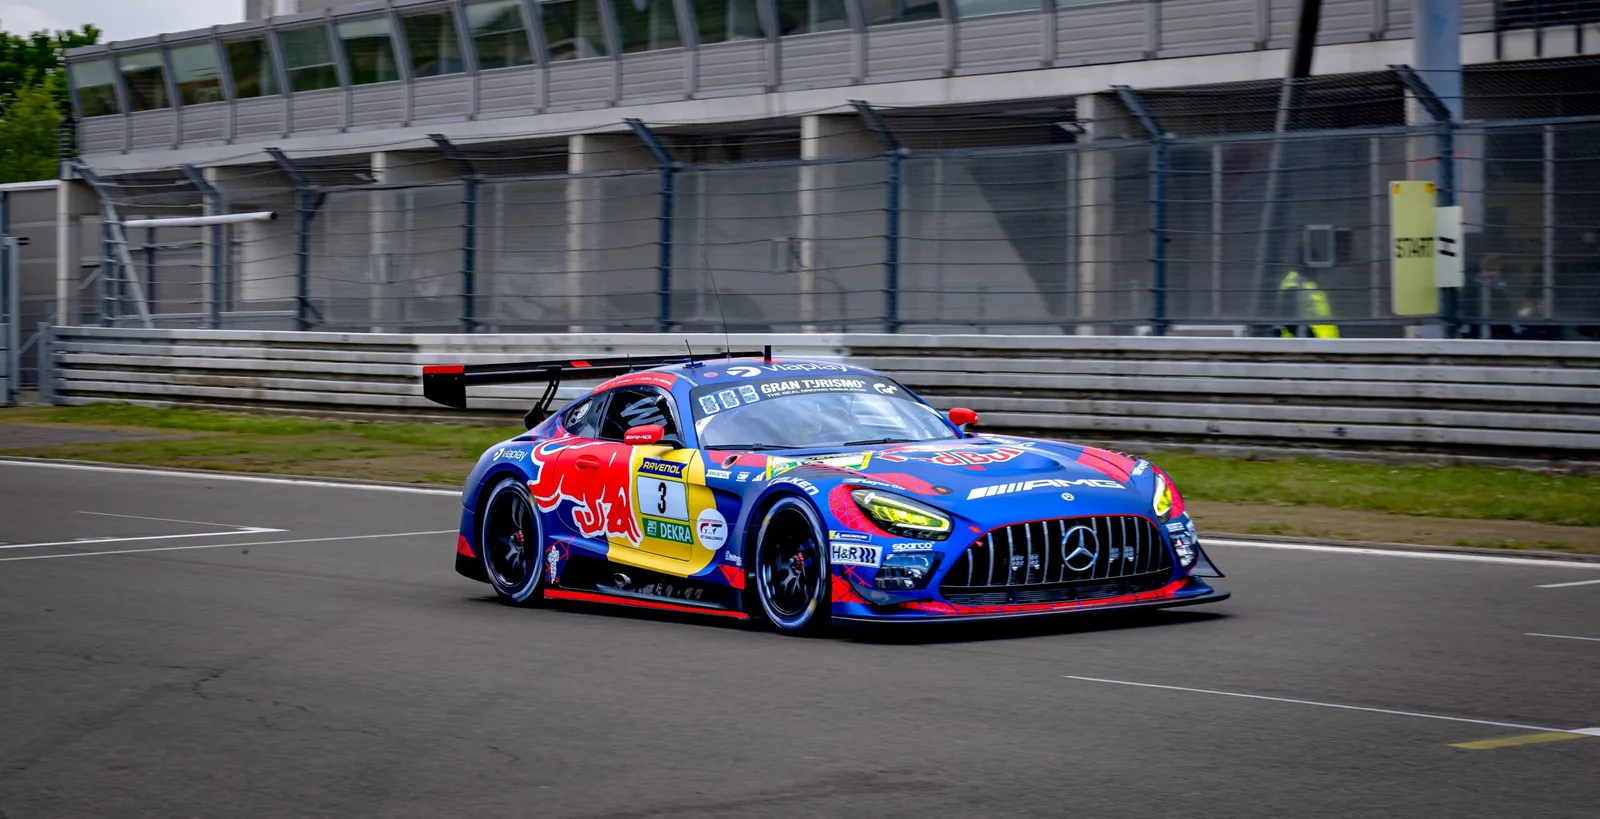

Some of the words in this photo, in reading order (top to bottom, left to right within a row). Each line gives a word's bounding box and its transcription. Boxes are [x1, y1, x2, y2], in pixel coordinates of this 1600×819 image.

[760, 380, 800, 394] GRAN
[801, 379, 861, 389] TURISMO
[643, 461, 681, 474] RAVENOL
[657, 481, 667, 514] 3
[660, 522, 692, 543] DEKRA
[832, 545, 857, 558] H&R
[892, 542, 933, 552] sparco
